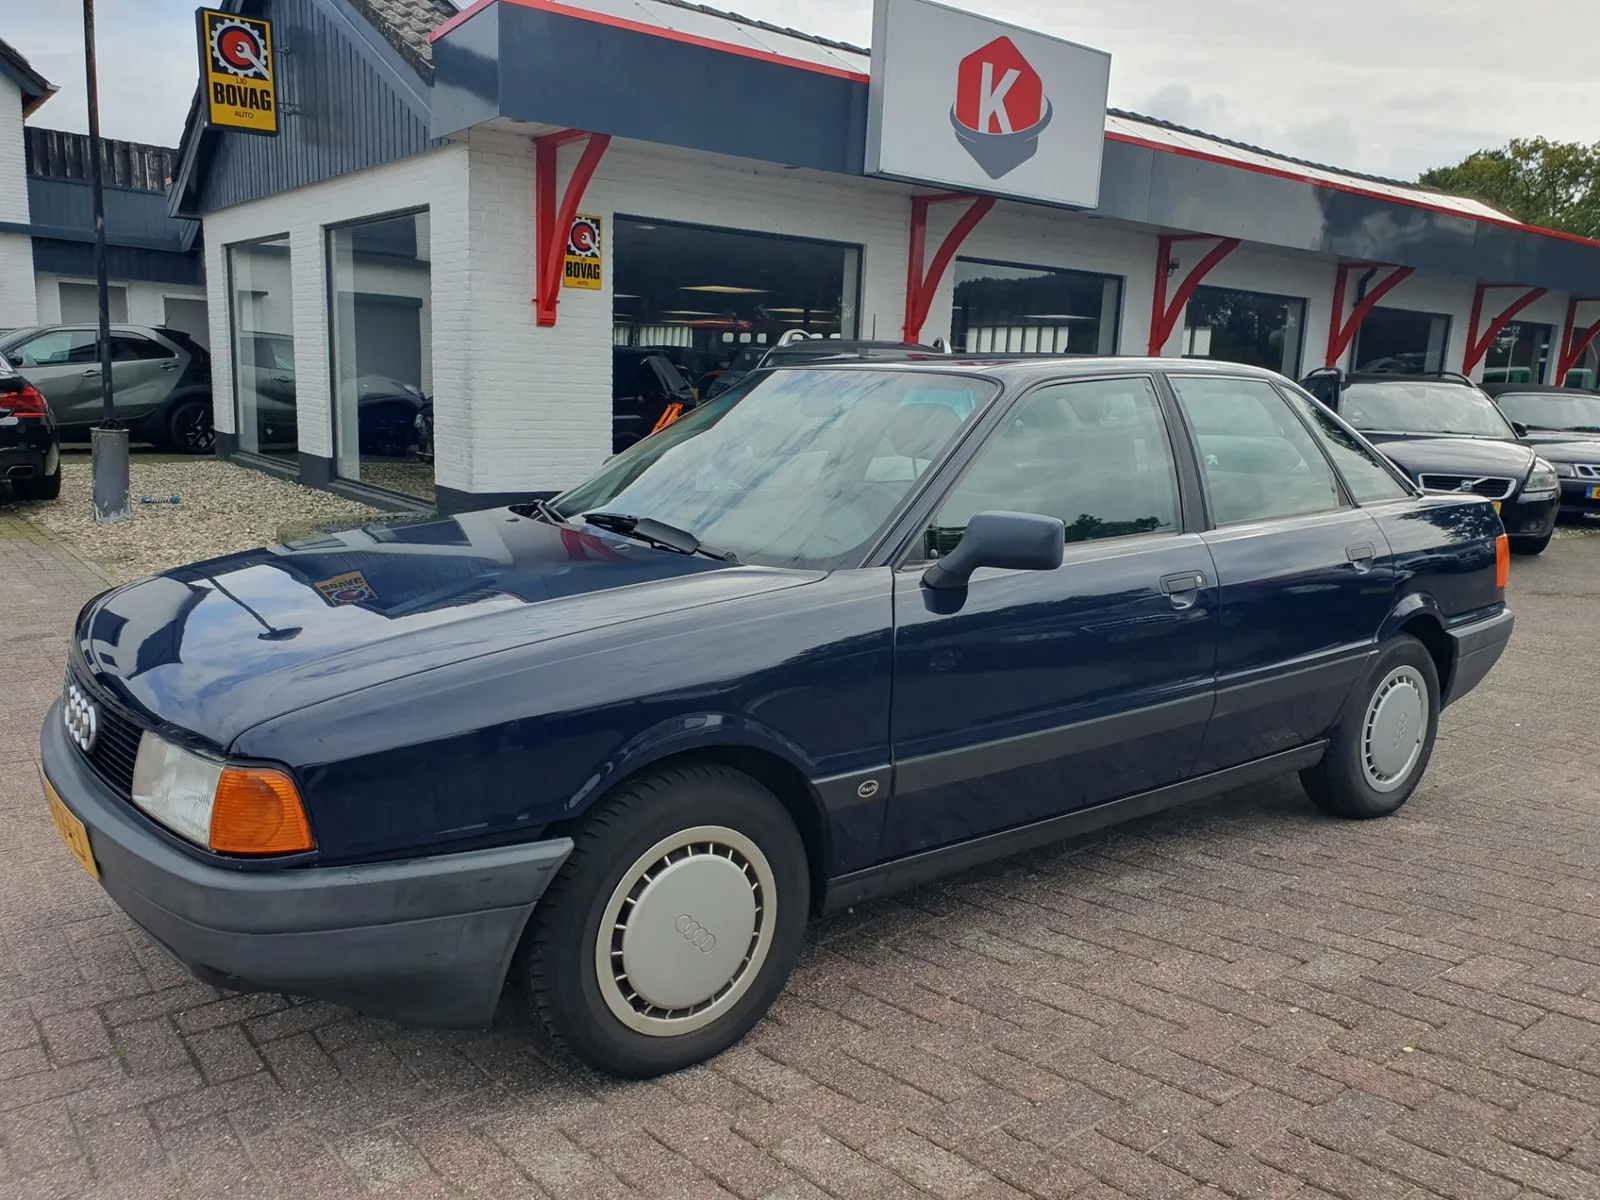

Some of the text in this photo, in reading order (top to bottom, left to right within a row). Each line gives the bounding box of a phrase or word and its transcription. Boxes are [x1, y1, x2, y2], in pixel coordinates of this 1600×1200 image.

[213, 81, 272, 112] BOVAG
[978, 61, 1021, 134] K
[234, 110, 254, 119] AUTO
[565, 260, 600, 280] BOVAG
